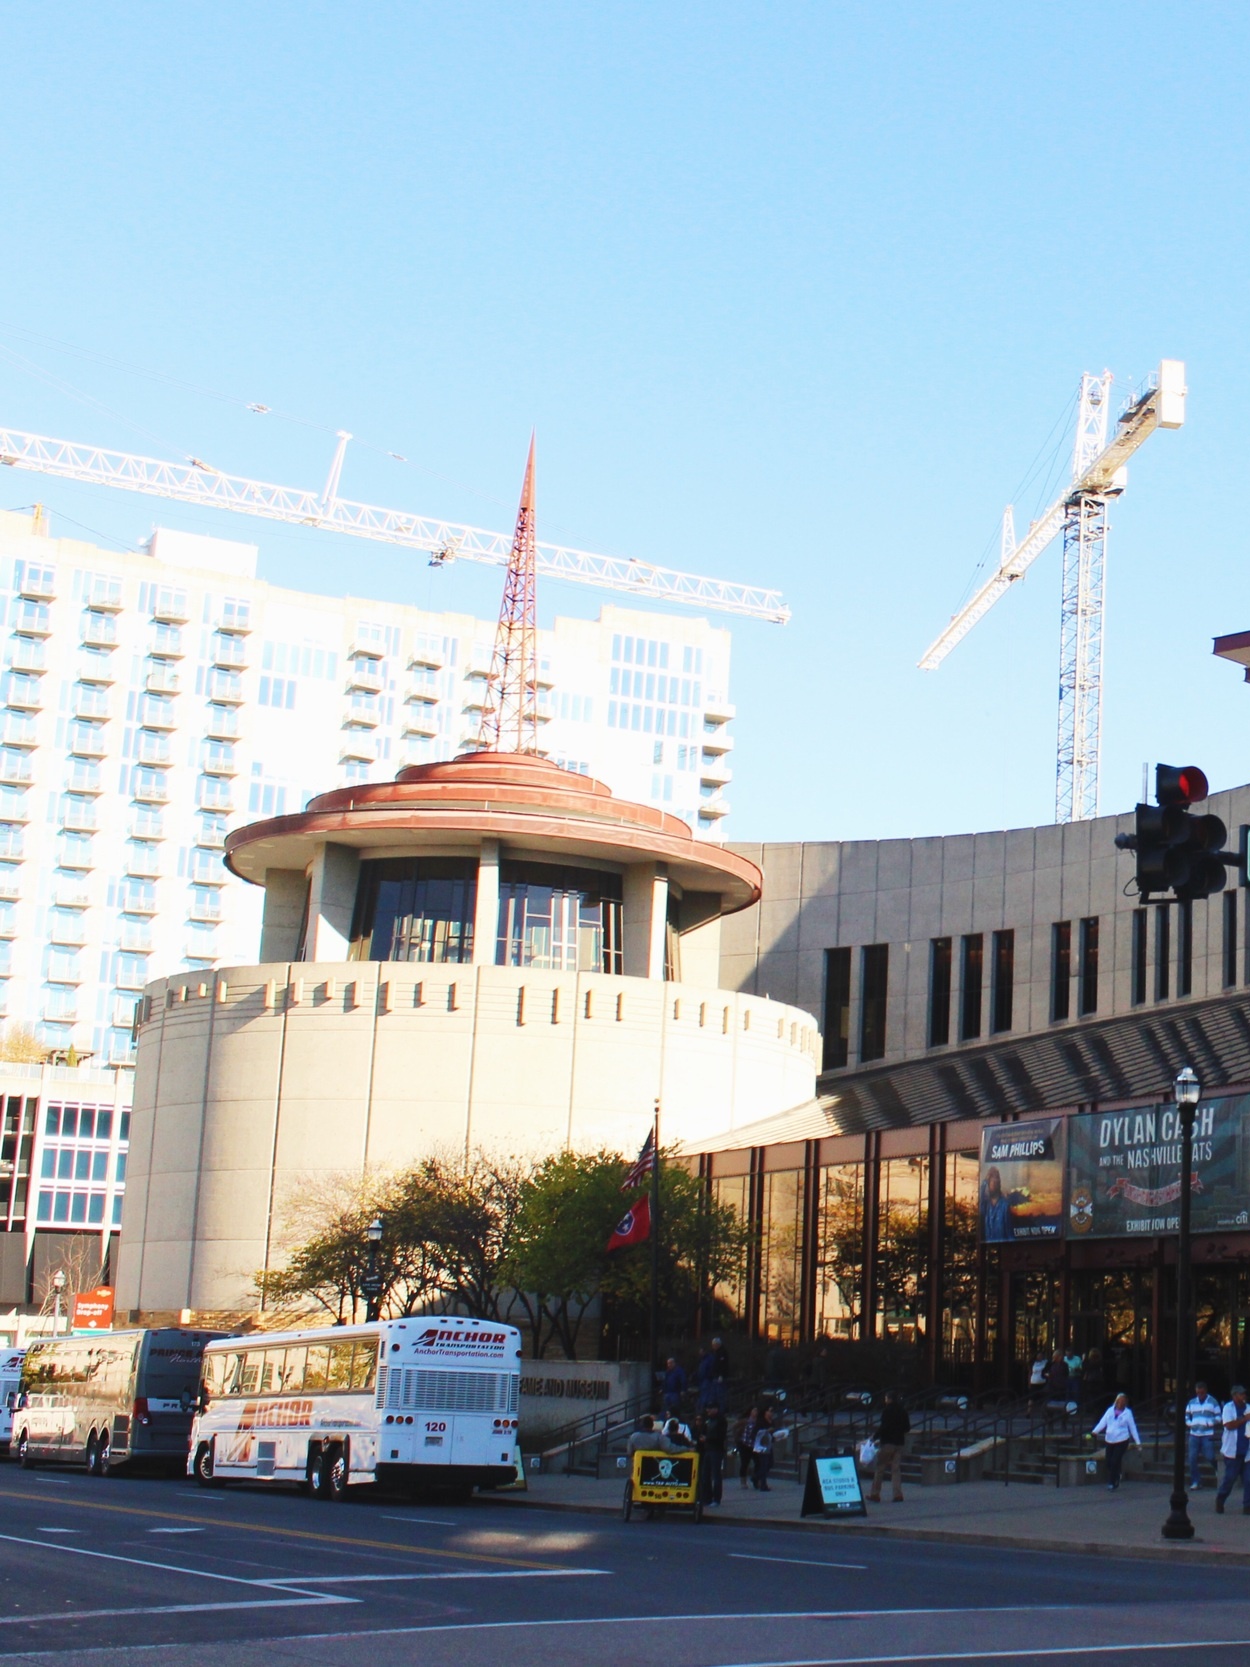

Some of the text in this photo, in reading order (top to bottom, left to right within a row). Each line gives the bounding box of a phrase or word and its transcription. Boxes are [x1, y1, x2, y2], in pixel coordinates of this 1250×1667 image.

[1100, 1113, 1156, 1148] DYLAN
[992, 1140, 1045, 1159] SAM PHILLIPS
[1099, 1141, 1213, 1169] AND THE NASHVILLE ATS
[1126, 1219, 1151, 1232] EXHIBIT
[1166, 1217, 1180, 1230] OPE
[1236, 1211, 1248, 1225] citi
[1041, 1225, 1057, 1235] OPEN
[77, 1302, 109, 1311] Symphony
[412, 1329, 506, 1346] ANCHOR
[414, 1348, 504, 1359] AnchorTransportation.com
[435, 1342, 505, 1350] TRANSPORTATION
[545, 1378, 565, 1398] AND
[566, 1379, 610, 1401] MUSEUM
[228, 1400, 314, 1438] ANCHOR
[425, 1422, 446, 1432] 120
